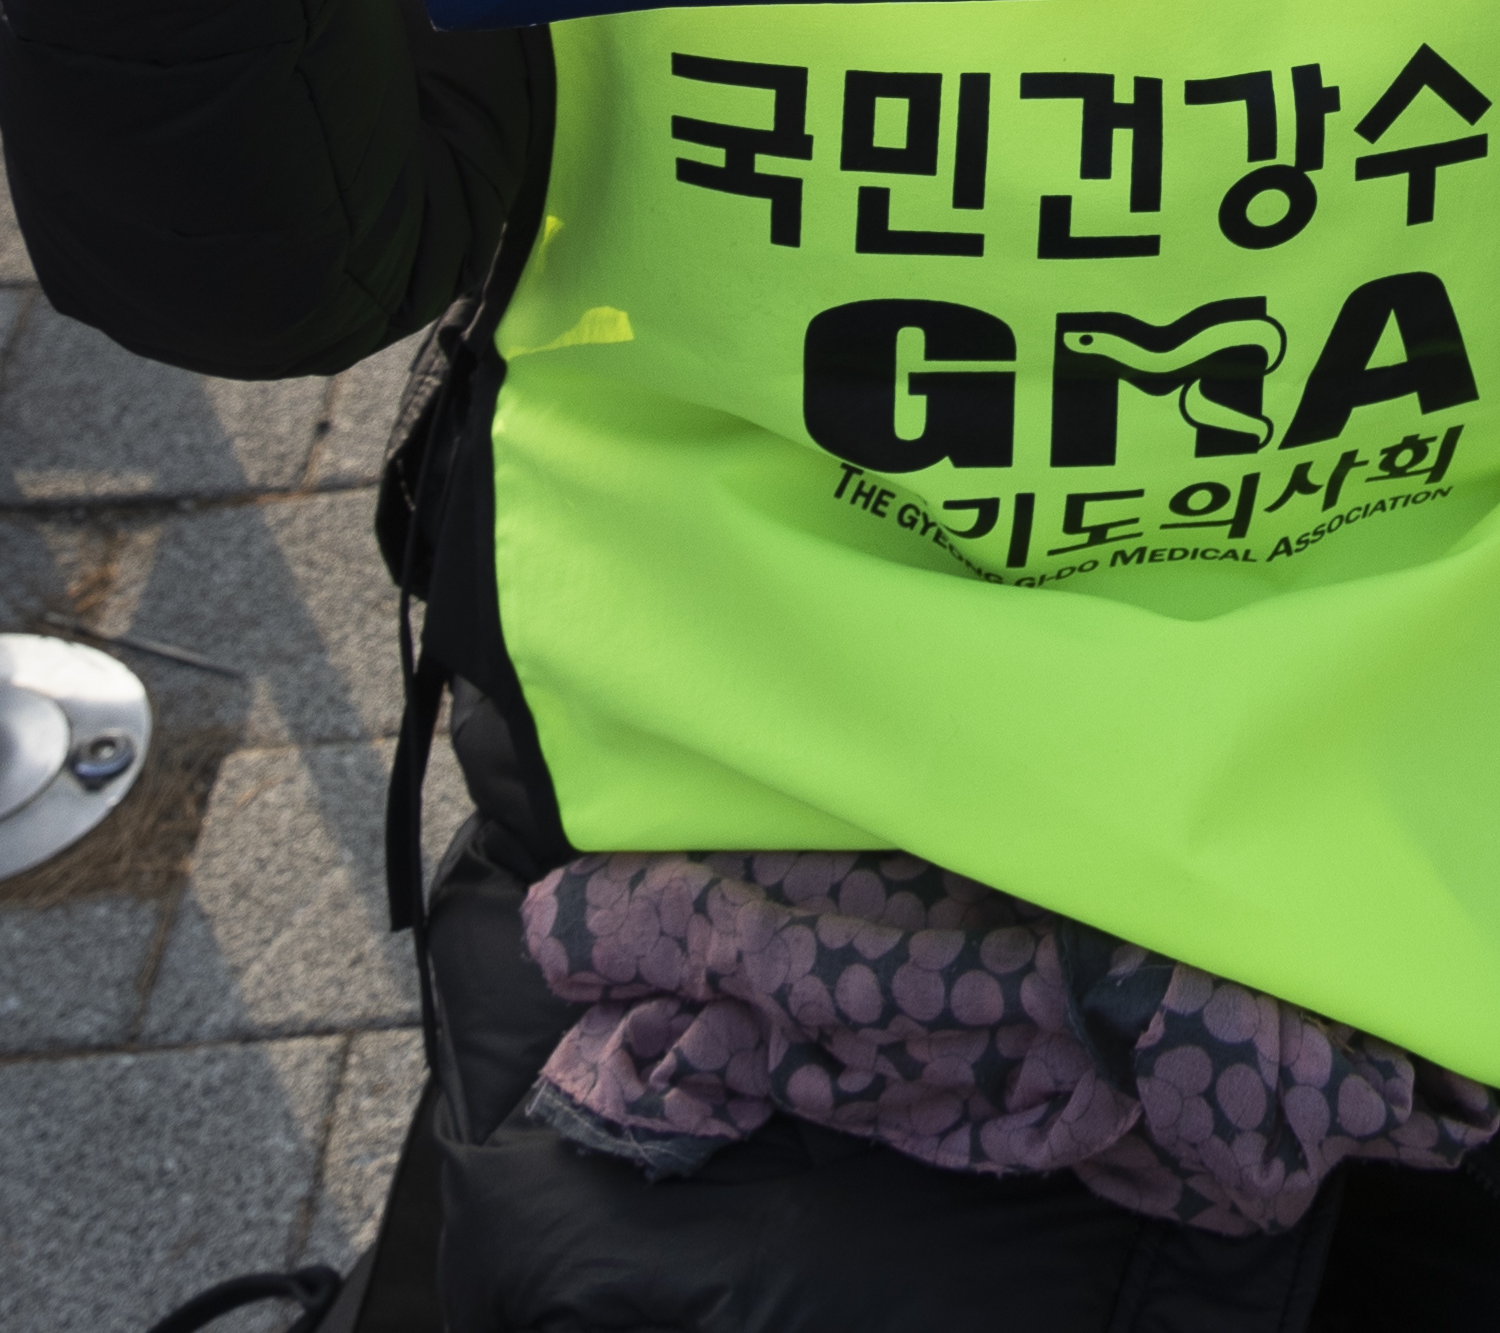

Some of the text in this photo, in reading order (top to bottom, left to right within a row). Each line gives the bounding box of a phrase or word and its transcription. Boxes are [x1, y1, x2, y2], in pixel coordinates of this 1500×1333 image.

[803, 271, 1480, 474] GMA
[833, 462, 896, 519] THE
[1108, 545, 1258, 568] MEDICAL
[1265, 485, 1454, 563] ASSOCIATION
[942, 424, 1465, 569] 기도의사회
